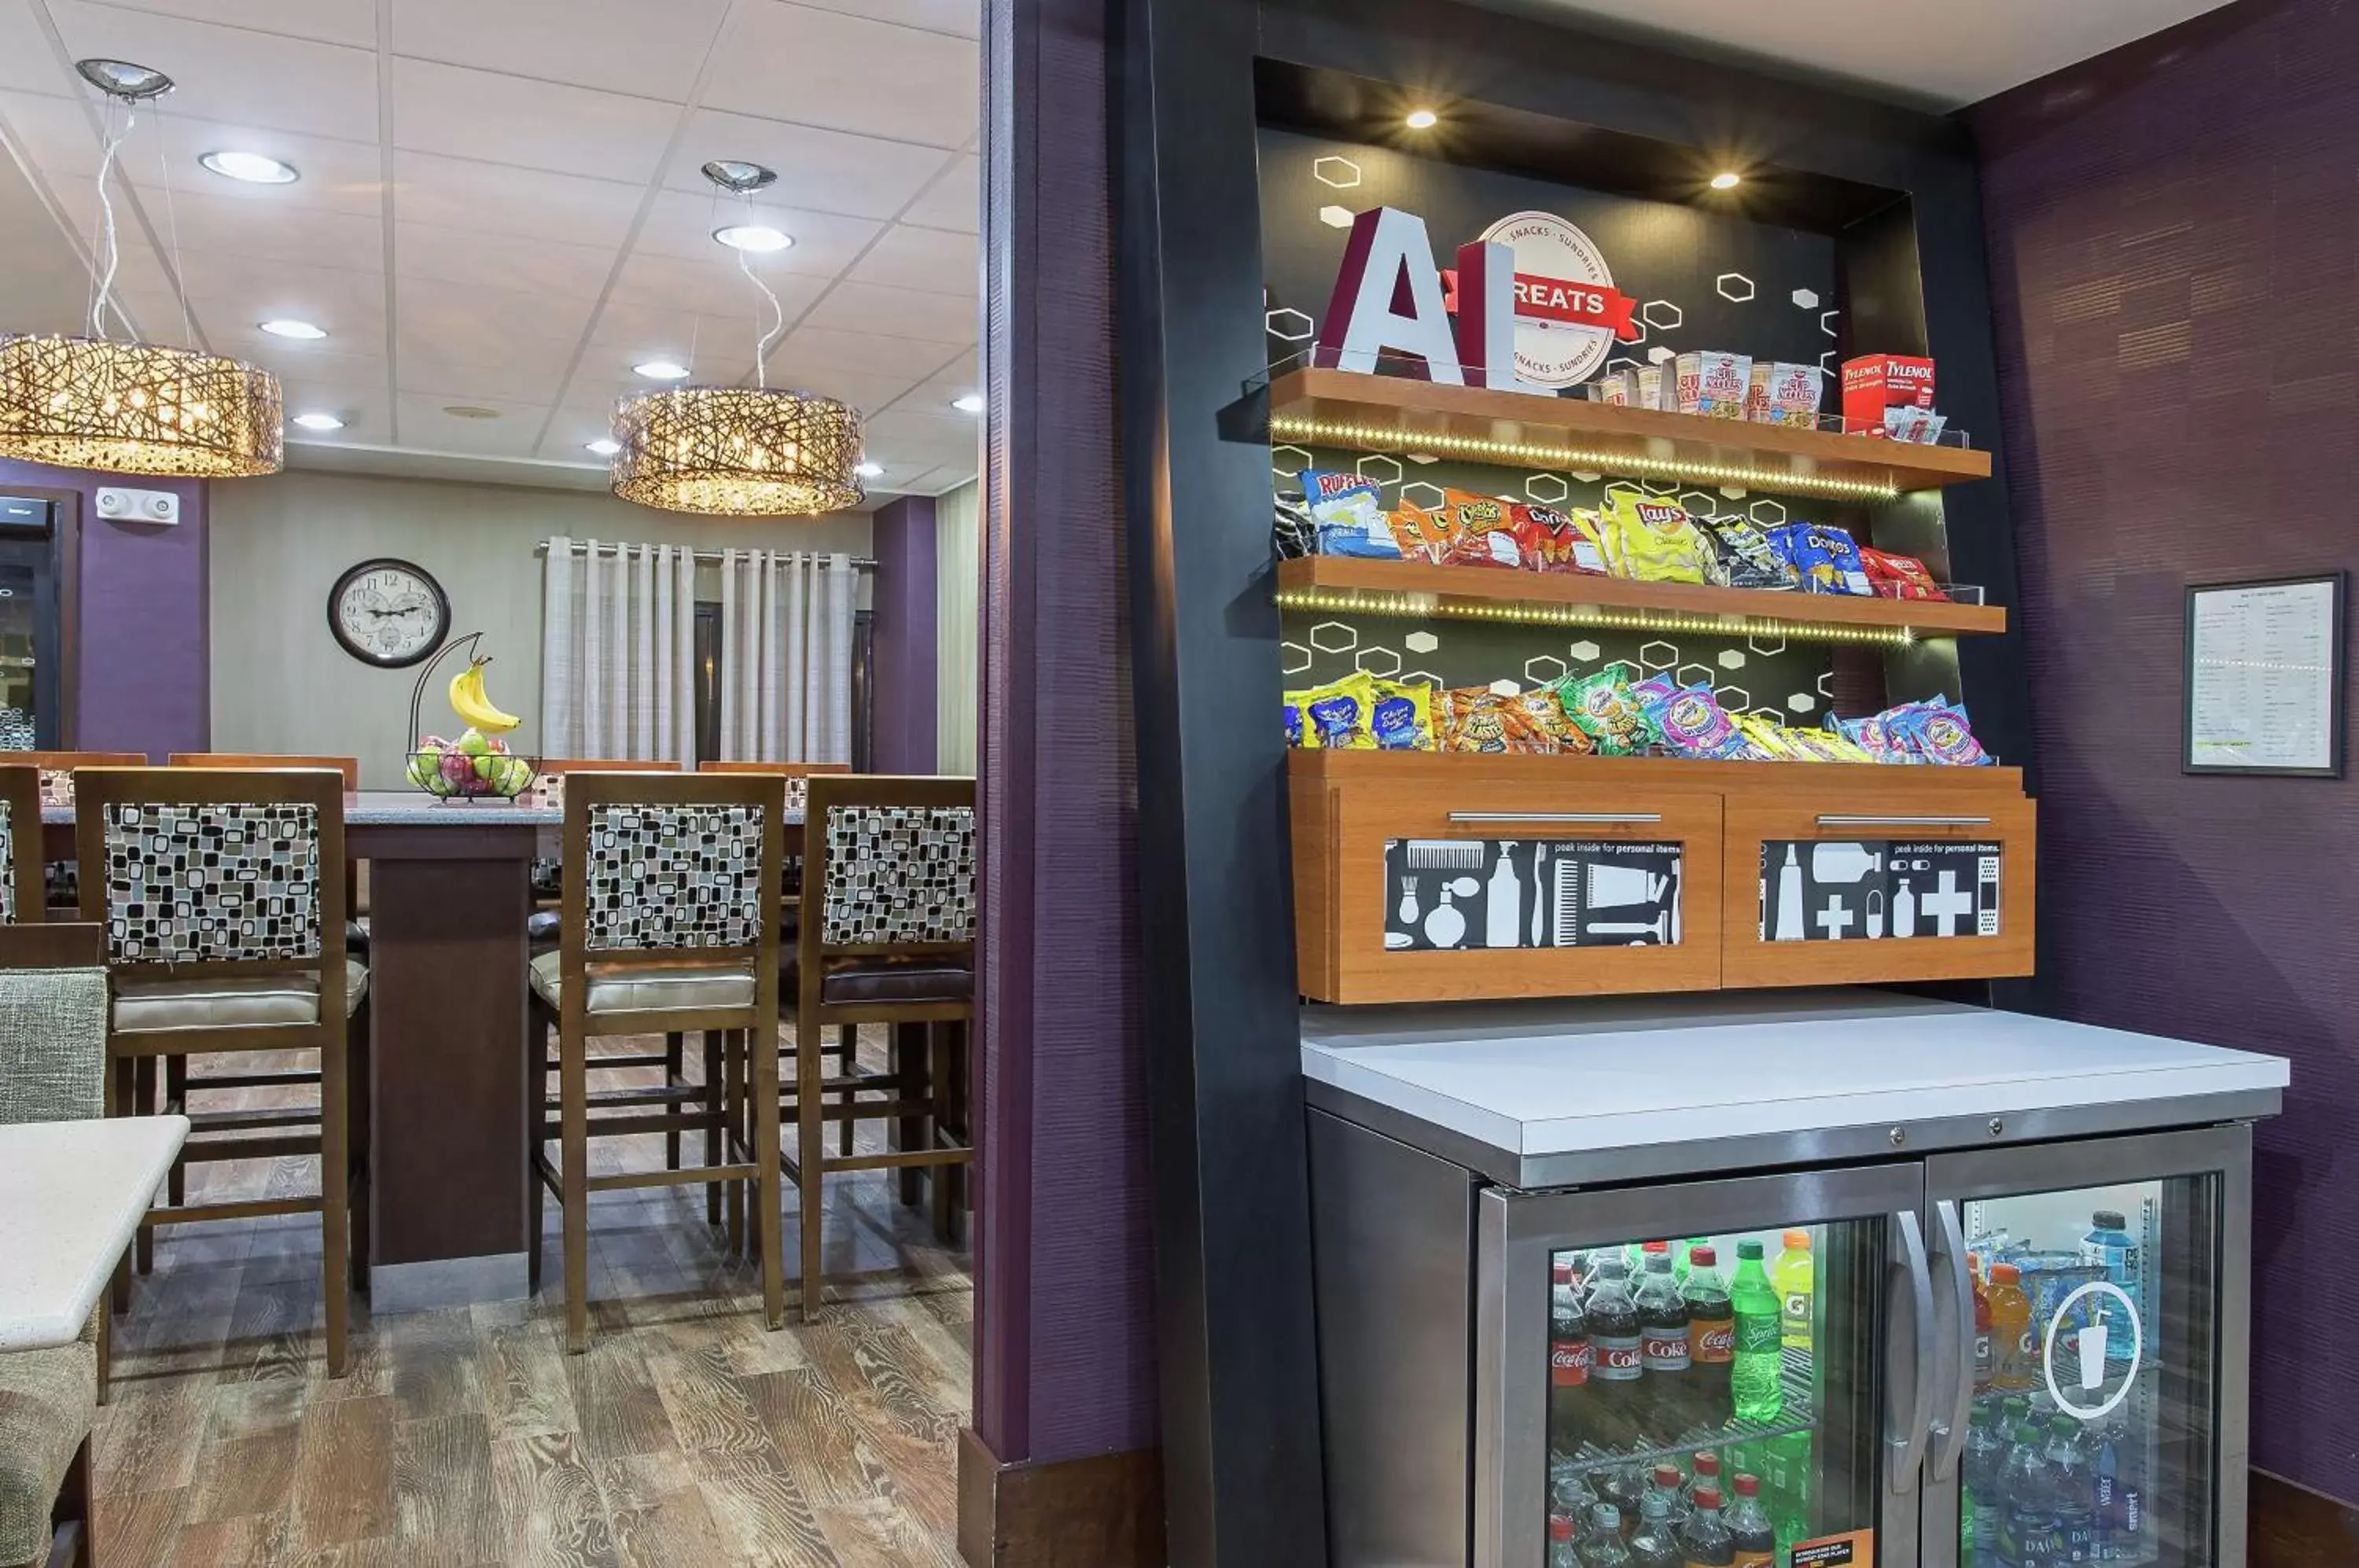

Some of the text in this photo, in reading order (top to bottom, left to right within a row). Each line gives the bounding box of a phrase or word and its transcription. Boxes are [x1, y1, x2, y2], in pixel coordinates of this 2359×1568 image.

[1510, 226, 1599, 280] SNACKS SUNDRIES
[1514, 281, 1605, 314] REATS
[1887, 361, 1932, 379] TYLENOL
[1808, 536, 1851, 556] Doritos
[1603, 843, 1615, 853] for
[1616, 844, 1654, 855] personal
[1913, 844, 1934, 854] inside
[1934, 844, 1945, 853] for
[1945, 844, 1976, 855] personal
[1786, 1294, 1805, 1316] G
[1647, 1340, 1688, 1359] Coke
